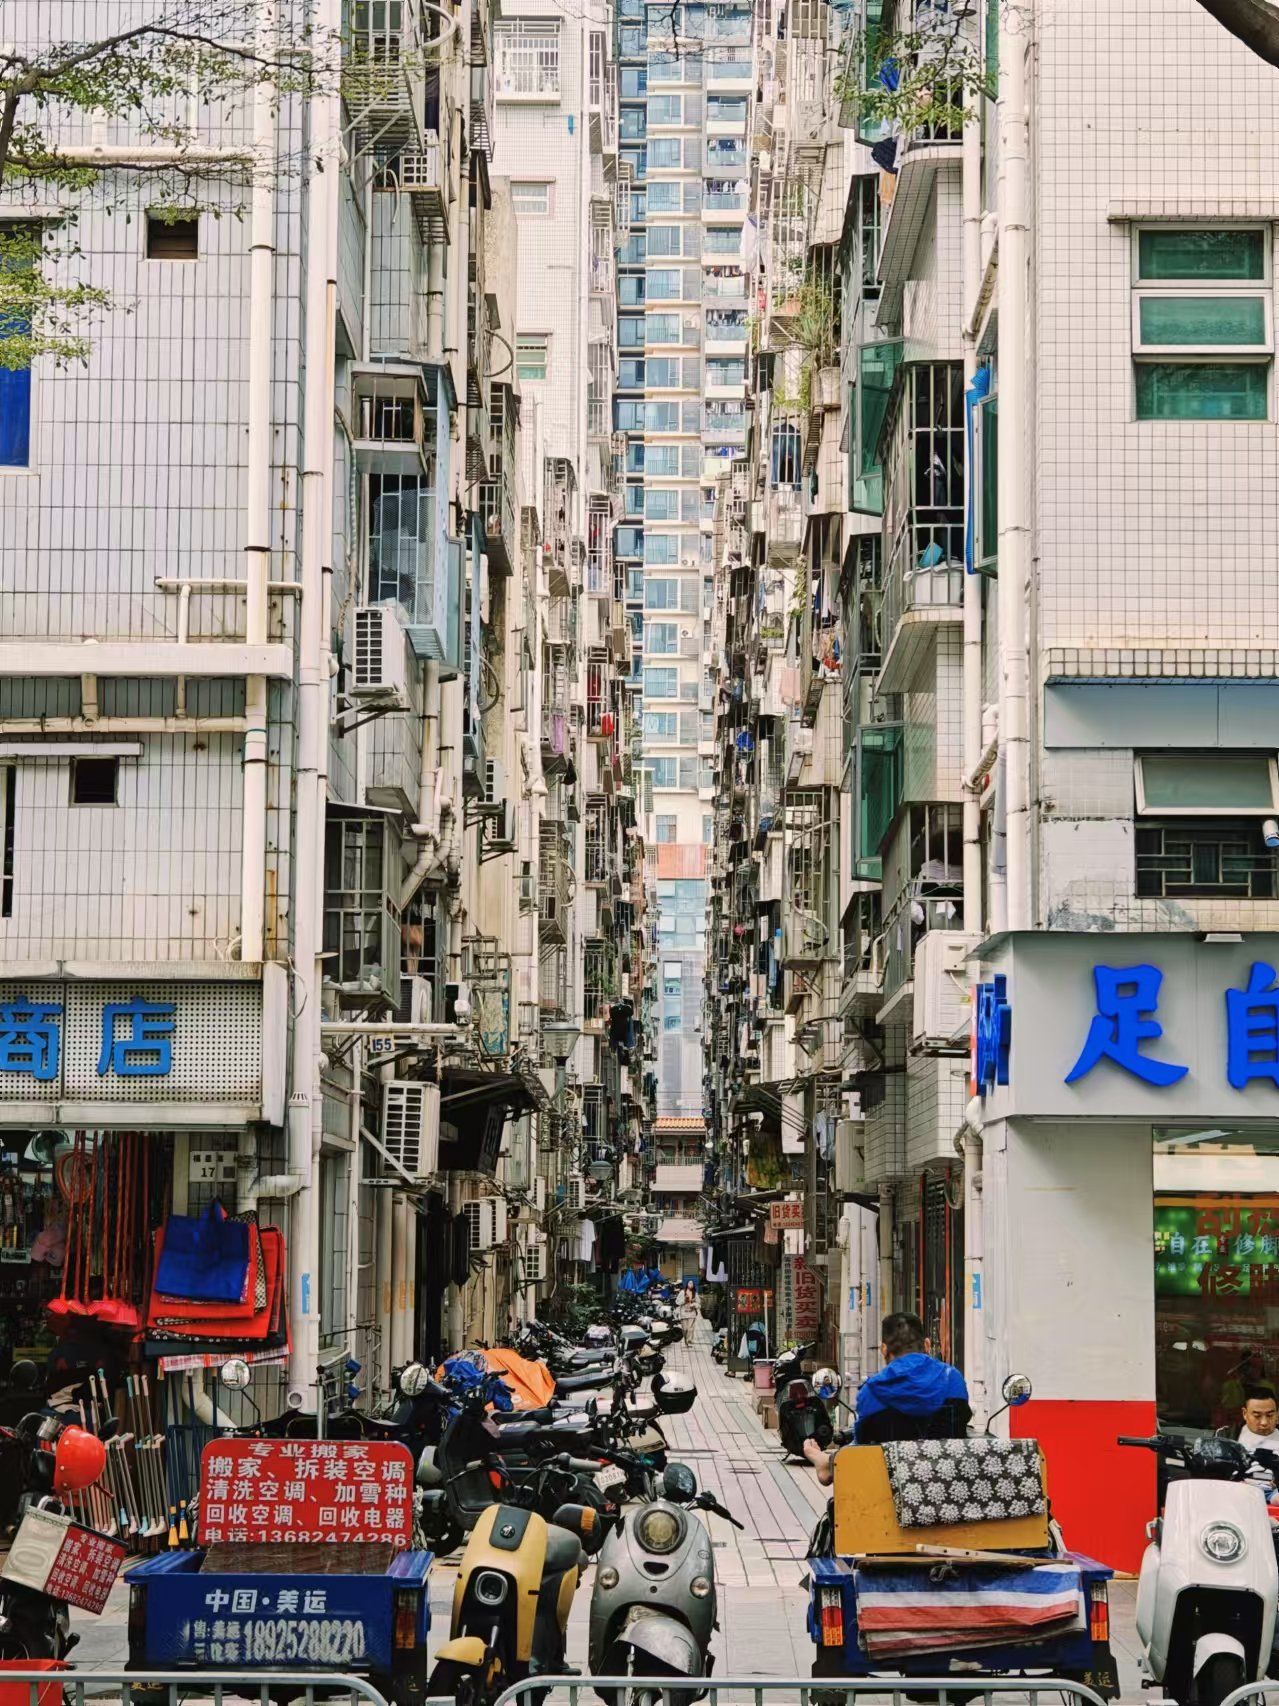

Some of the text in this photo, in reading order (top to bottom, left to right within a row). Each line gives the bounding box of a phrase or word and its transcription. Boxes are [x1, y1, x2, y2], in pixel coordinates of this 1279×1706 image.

[0, 995, 177, 1080] 商店
[372, 1038, 392, 1051] 155
[201, 1167, 216, 1178] 17
[773, 1203, 804, 1219] 旧货买
[248, 1442, 369, 1459] 专业搬家
[206, 1503, 405, 1529] 回收空调、回收电器
[205, 1589, 327, 1614] 中国·美运
